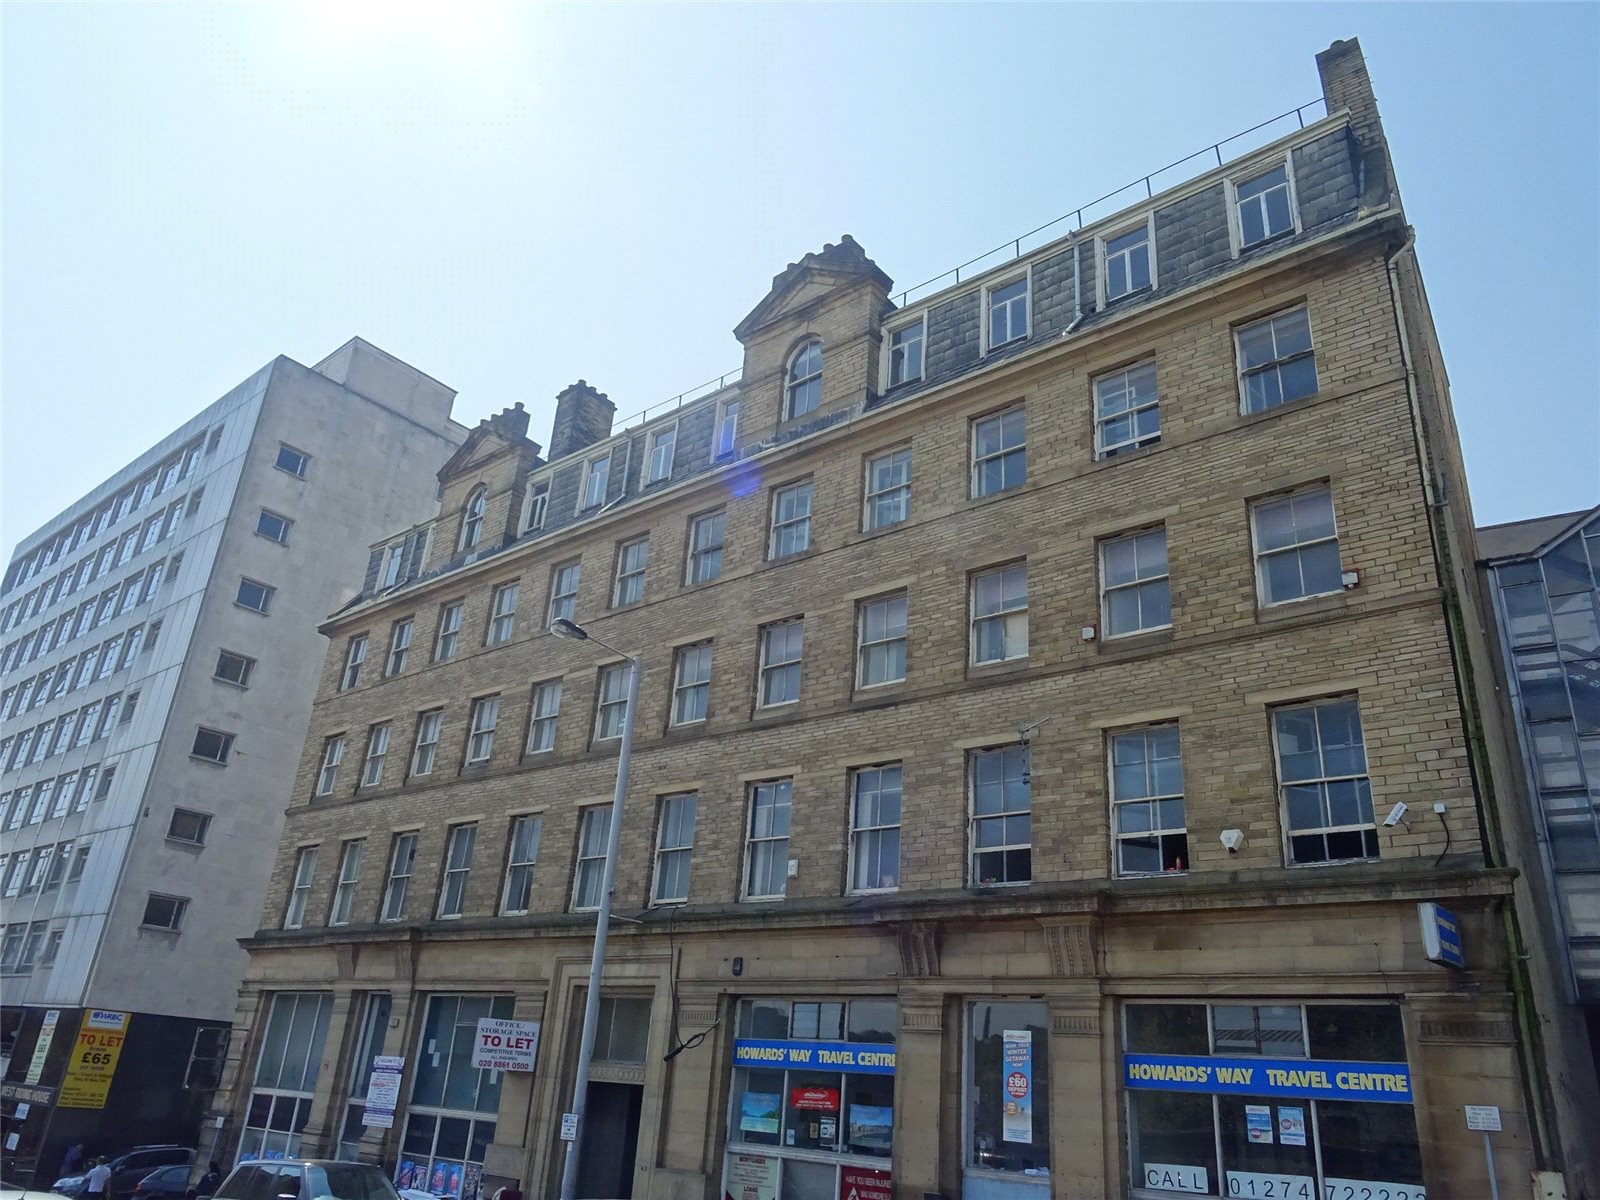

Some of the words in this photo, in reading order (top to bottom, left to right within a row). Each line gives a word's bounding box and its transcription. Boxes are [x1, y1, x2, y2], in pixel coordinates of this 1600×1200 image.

[481, 1027, 513, 1035] STORAGE
[515, 1030, 536, 1038] SPACE
[80, 1033, 96, 1045] TO
[99, 1035, 123, 1047] LET
[482, 1034, 502, 1047] TO
[506, 1037, 534, 1050] LET
[480, 1047, 513, 1056] COMPETITIVE
[736, 1046, 788, 1061] HOWARDS'
[789, 1049, 812, 1062] WAY
[818, 1050, 855, 1065] TRAVEL
[81, 1052, 112, 1065] £65
[478, 1059, 492, 1067] 020
[493, 1060, 510, 1068] 8861
[511, 1062, 529, 1070] 0500
[1008, 1077, 1027, 1088] £60
[1129, 1063, 1212, 1083] HOWARDS'
[1215, 1067, 1254, 1085] WAY
[1266, 1069, 1332, 1089] TRAVEL
[1335, 1072, 1409, 1092] CENTRE
[1147, 1169, 1204, 1190] CALL
[1230, 1177, 1310, 1200] 01274
